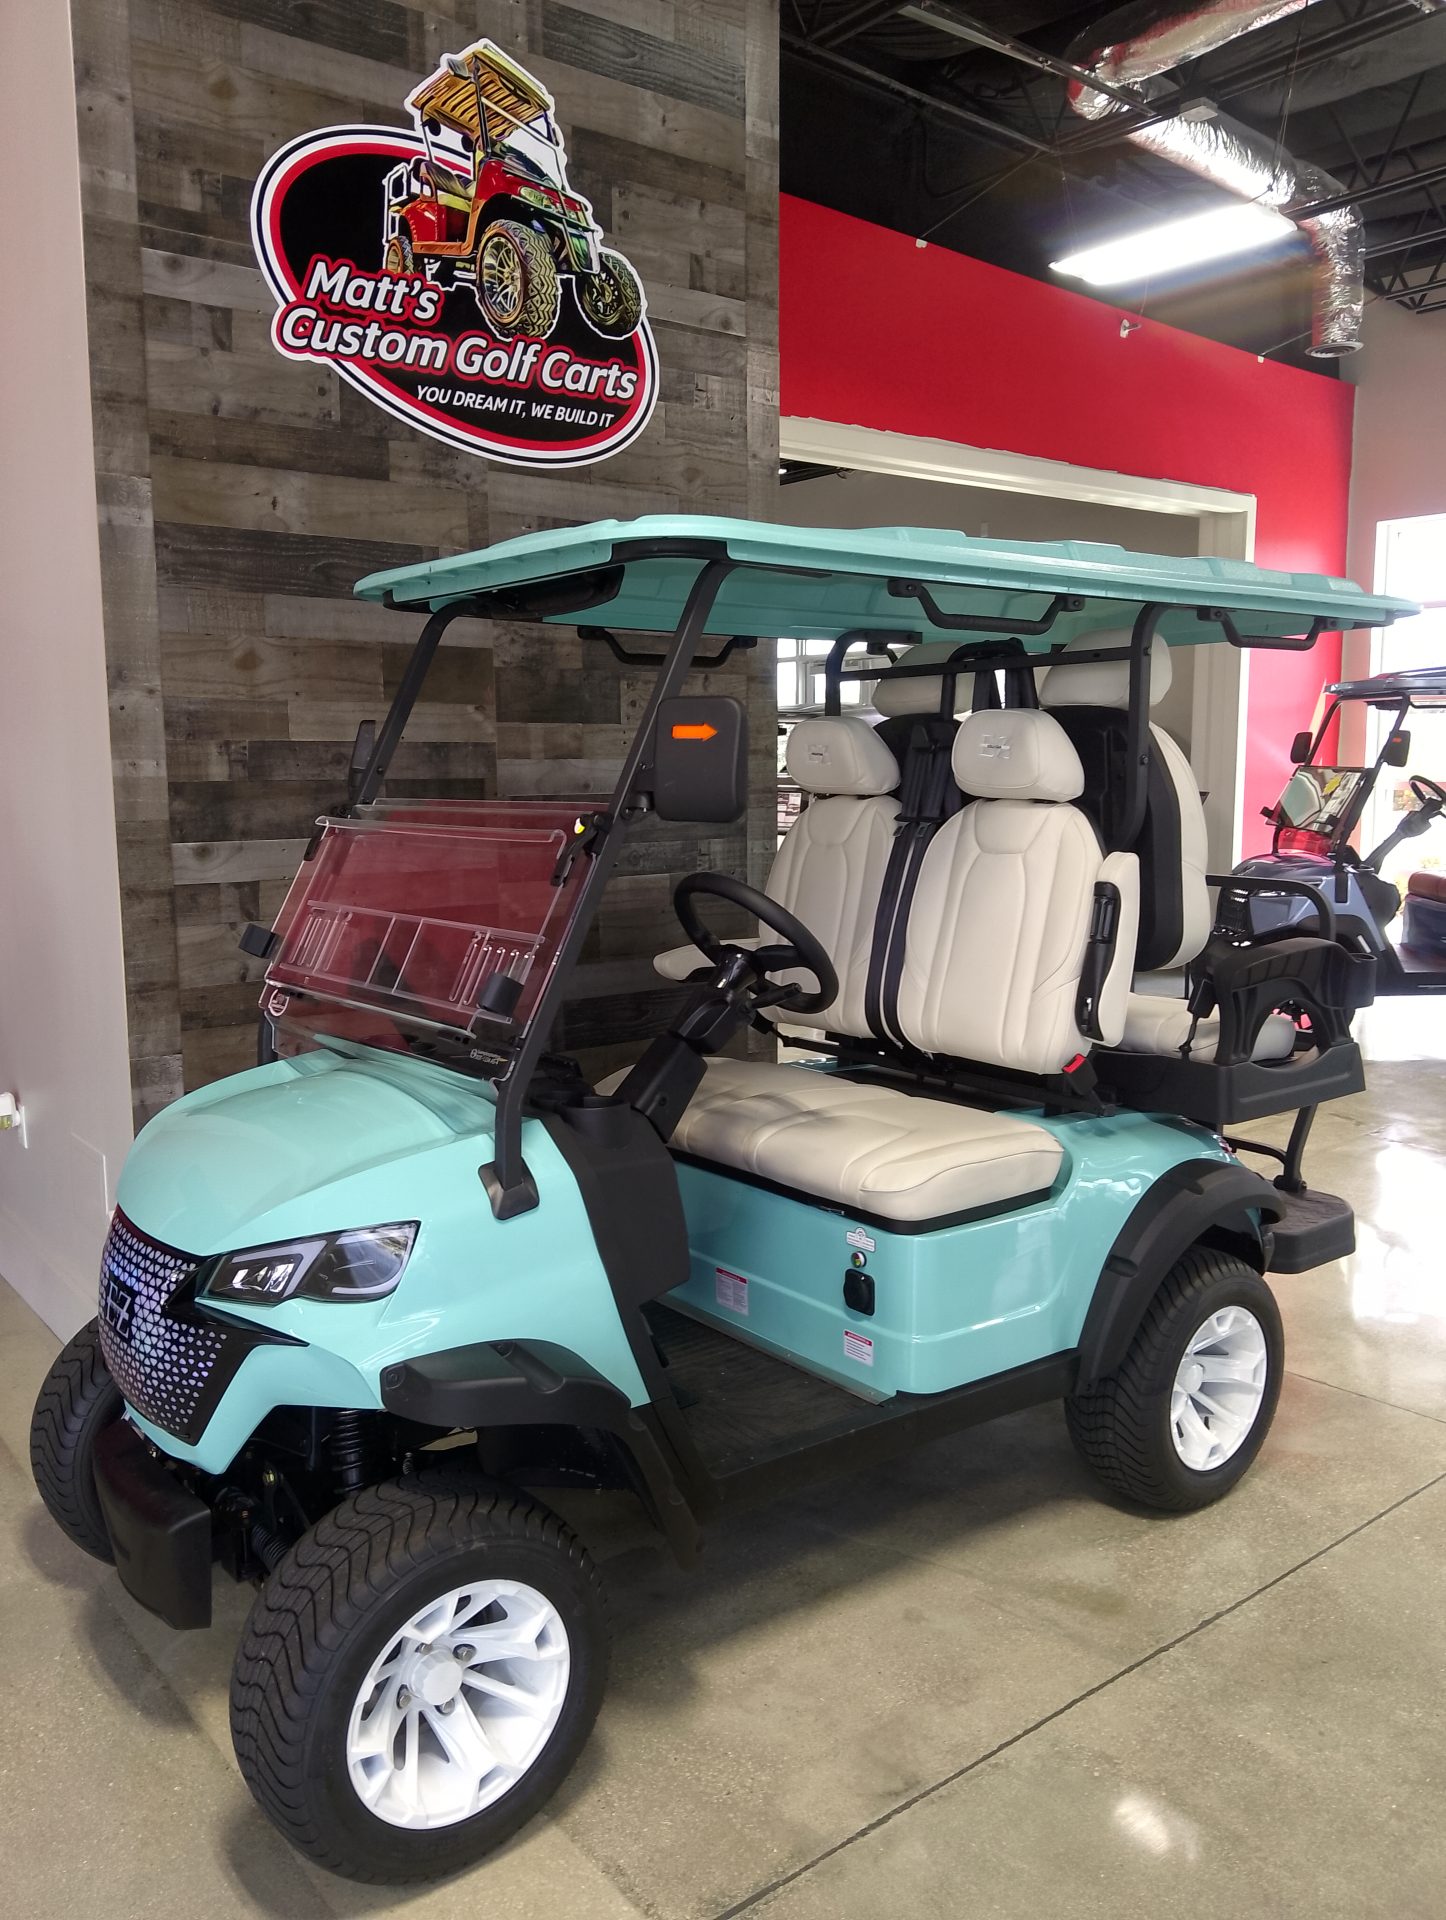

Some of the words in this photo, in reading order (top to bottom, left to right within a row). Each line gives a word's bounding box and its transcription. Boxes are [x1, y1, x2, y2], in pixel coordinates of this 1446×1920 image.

[306, 261, 440, 318] Matt's
[282, 307, 448, 369] Custom
[456, 337, 542, 382] Golf
[542, 352, 638, 399] Carts
[416, 385, 452, 404] YOU
[452, 391, 509, 413] DREAM
[508, 400, 526, 419] IT,
[531, 402, 556, 420] WE
[555, 406, 599, 426] BUILD
[599, 413, 615, 428] IT
